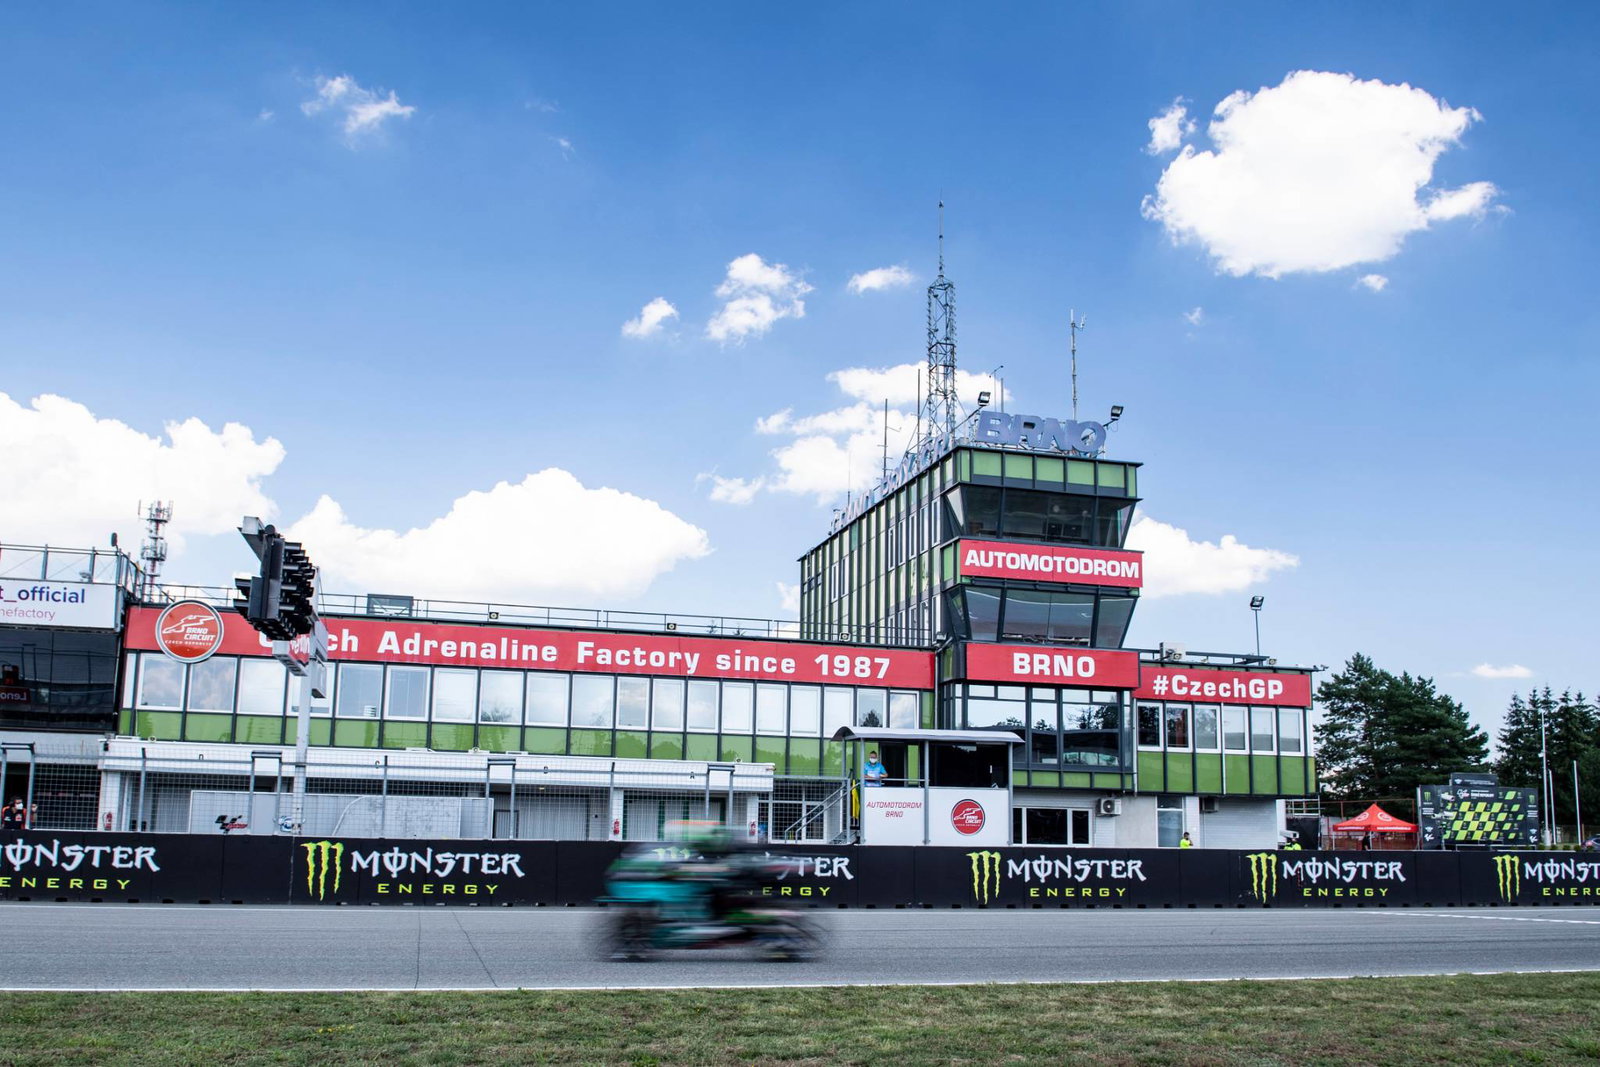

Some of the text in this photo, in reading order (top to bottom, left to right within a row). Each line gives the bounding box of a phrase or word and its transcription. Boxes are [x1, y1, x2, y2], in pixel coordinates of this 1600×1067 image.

[976, 411, 1106, 452] BRNO
[965, 549, 1140, 579] AUTOMOTODROM
[183, 633, 216, 641] CIRCUIT
[186, 627, 208, 635] BRNO
[377, 631, 558, 662] Adrenaline
[576, 641, 701, 675] Factory
[716, 649, 797, 674] since
[814, 653, 891, 679] 1987
[1012, 652, 1096, 678] BRNO
[1152, 674, 1284, 700] #CzechGP
[866, 801, 923, 809] AUTOMOTODROM
[885, 810, 904, 818] BRNO
[0, 838, 160, 873] ONSTER
[351, 846, 526, 878] MONSTER
[1007, 854, 1147, 883] MONSTER
[1282, 856, 1406, 884] MONSTER
[377, 883, 498, 895] ENERGY
[1030, 887, 1126, 897] ENERGY
[1303, 888, 1388, 897] ENERGY
